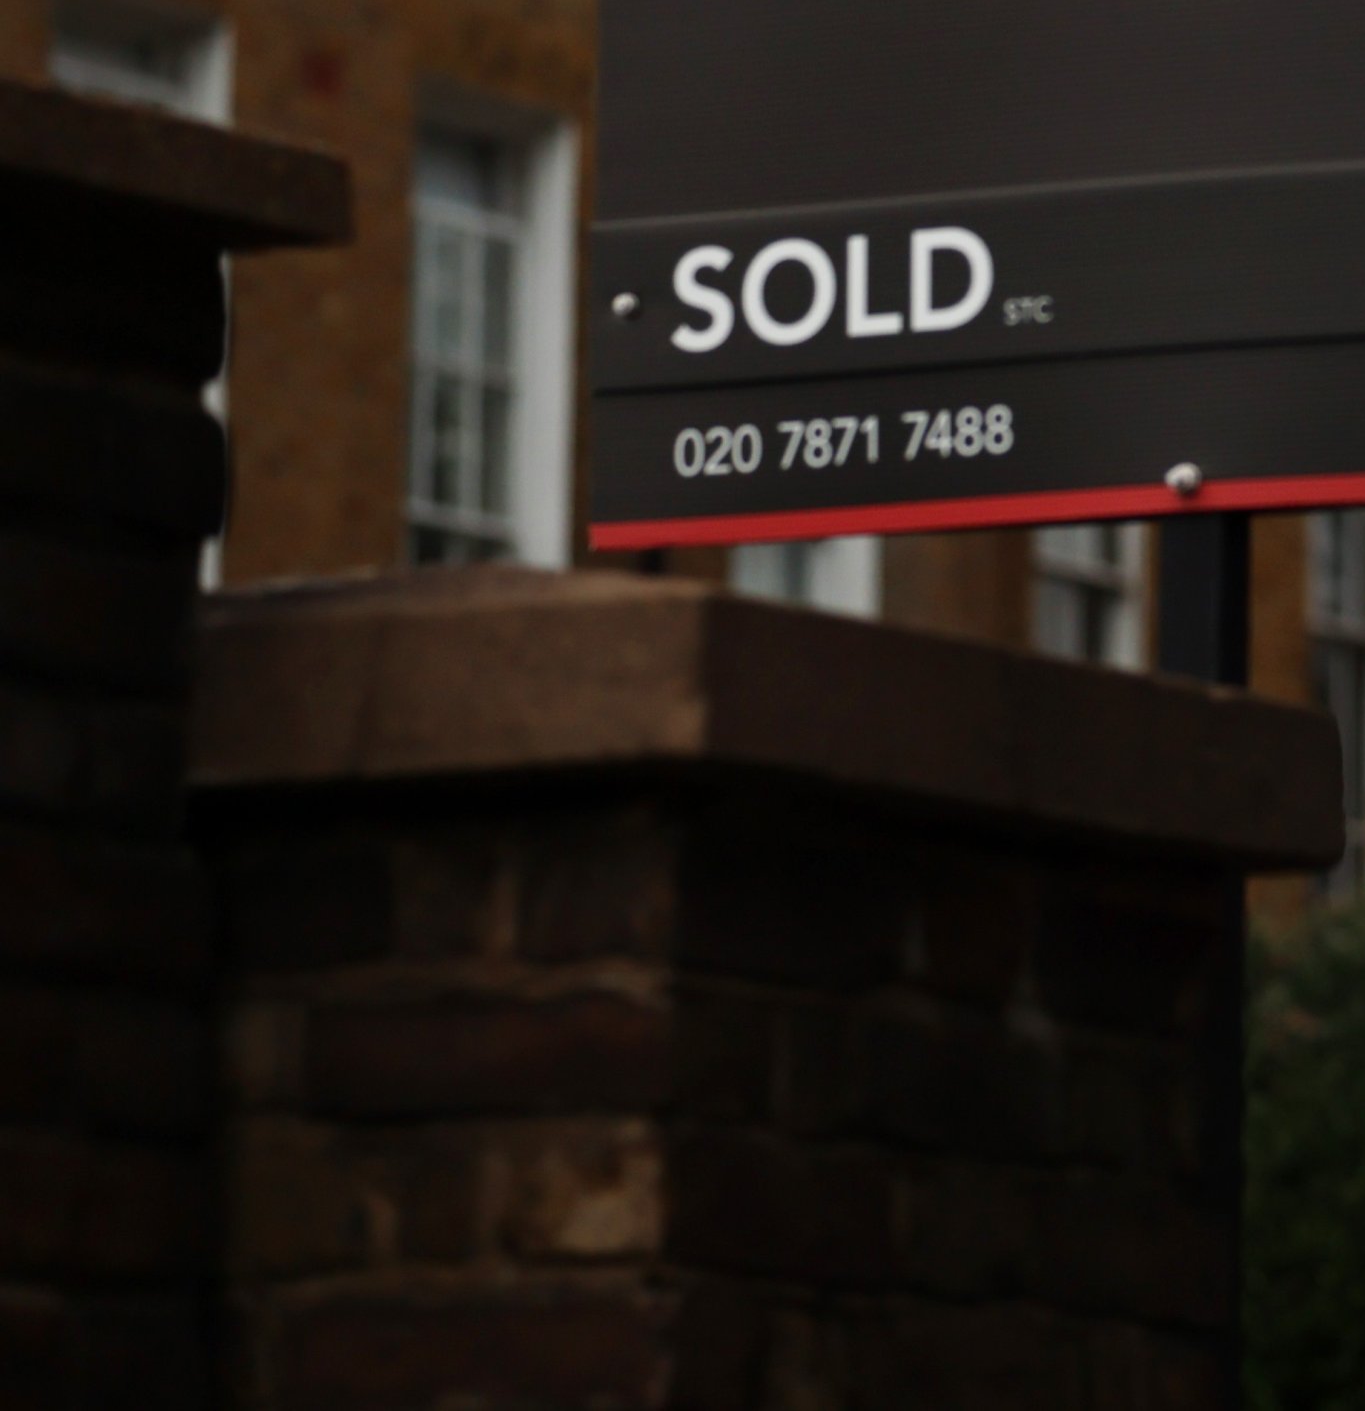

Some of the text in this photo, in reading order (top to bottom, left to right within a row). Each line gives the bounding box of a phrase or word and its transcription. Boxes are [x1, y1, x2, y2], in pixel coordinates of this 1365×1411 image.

[671, 226, 1053, 353] SOLD STC
[674, 404, 1014, 478] 020 7871 7488
